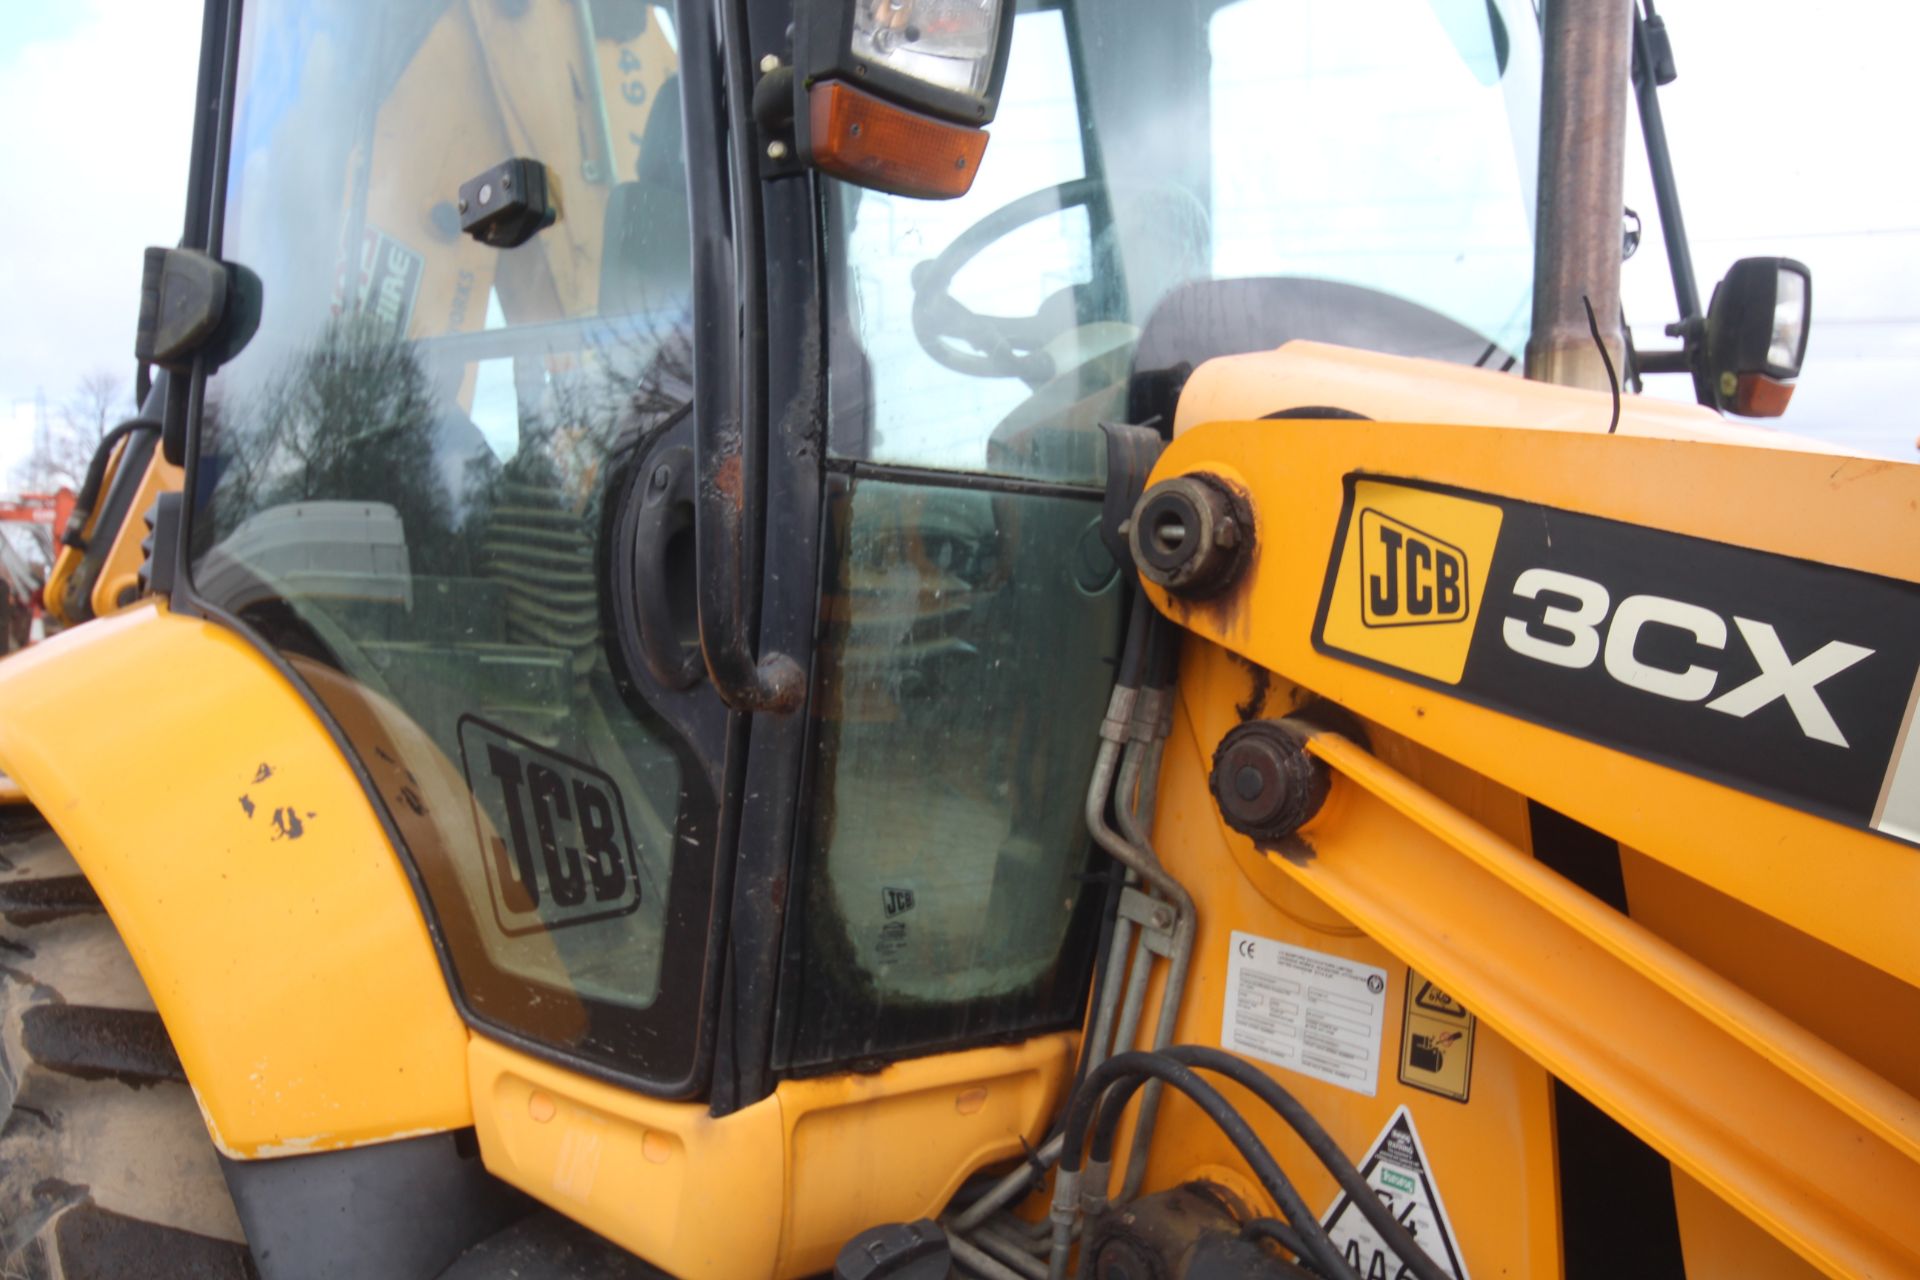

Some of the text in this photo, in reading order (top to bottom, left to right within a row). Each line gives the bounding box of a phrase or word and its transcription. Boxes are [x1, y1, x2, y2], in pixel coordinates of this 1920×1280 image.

[1368, 523, 1462, 618] JCB
[1501, 567, 1877, 750] 3CX
[486, 742, 627, 915] JCB
[886, 890, 914, 915] JCB
